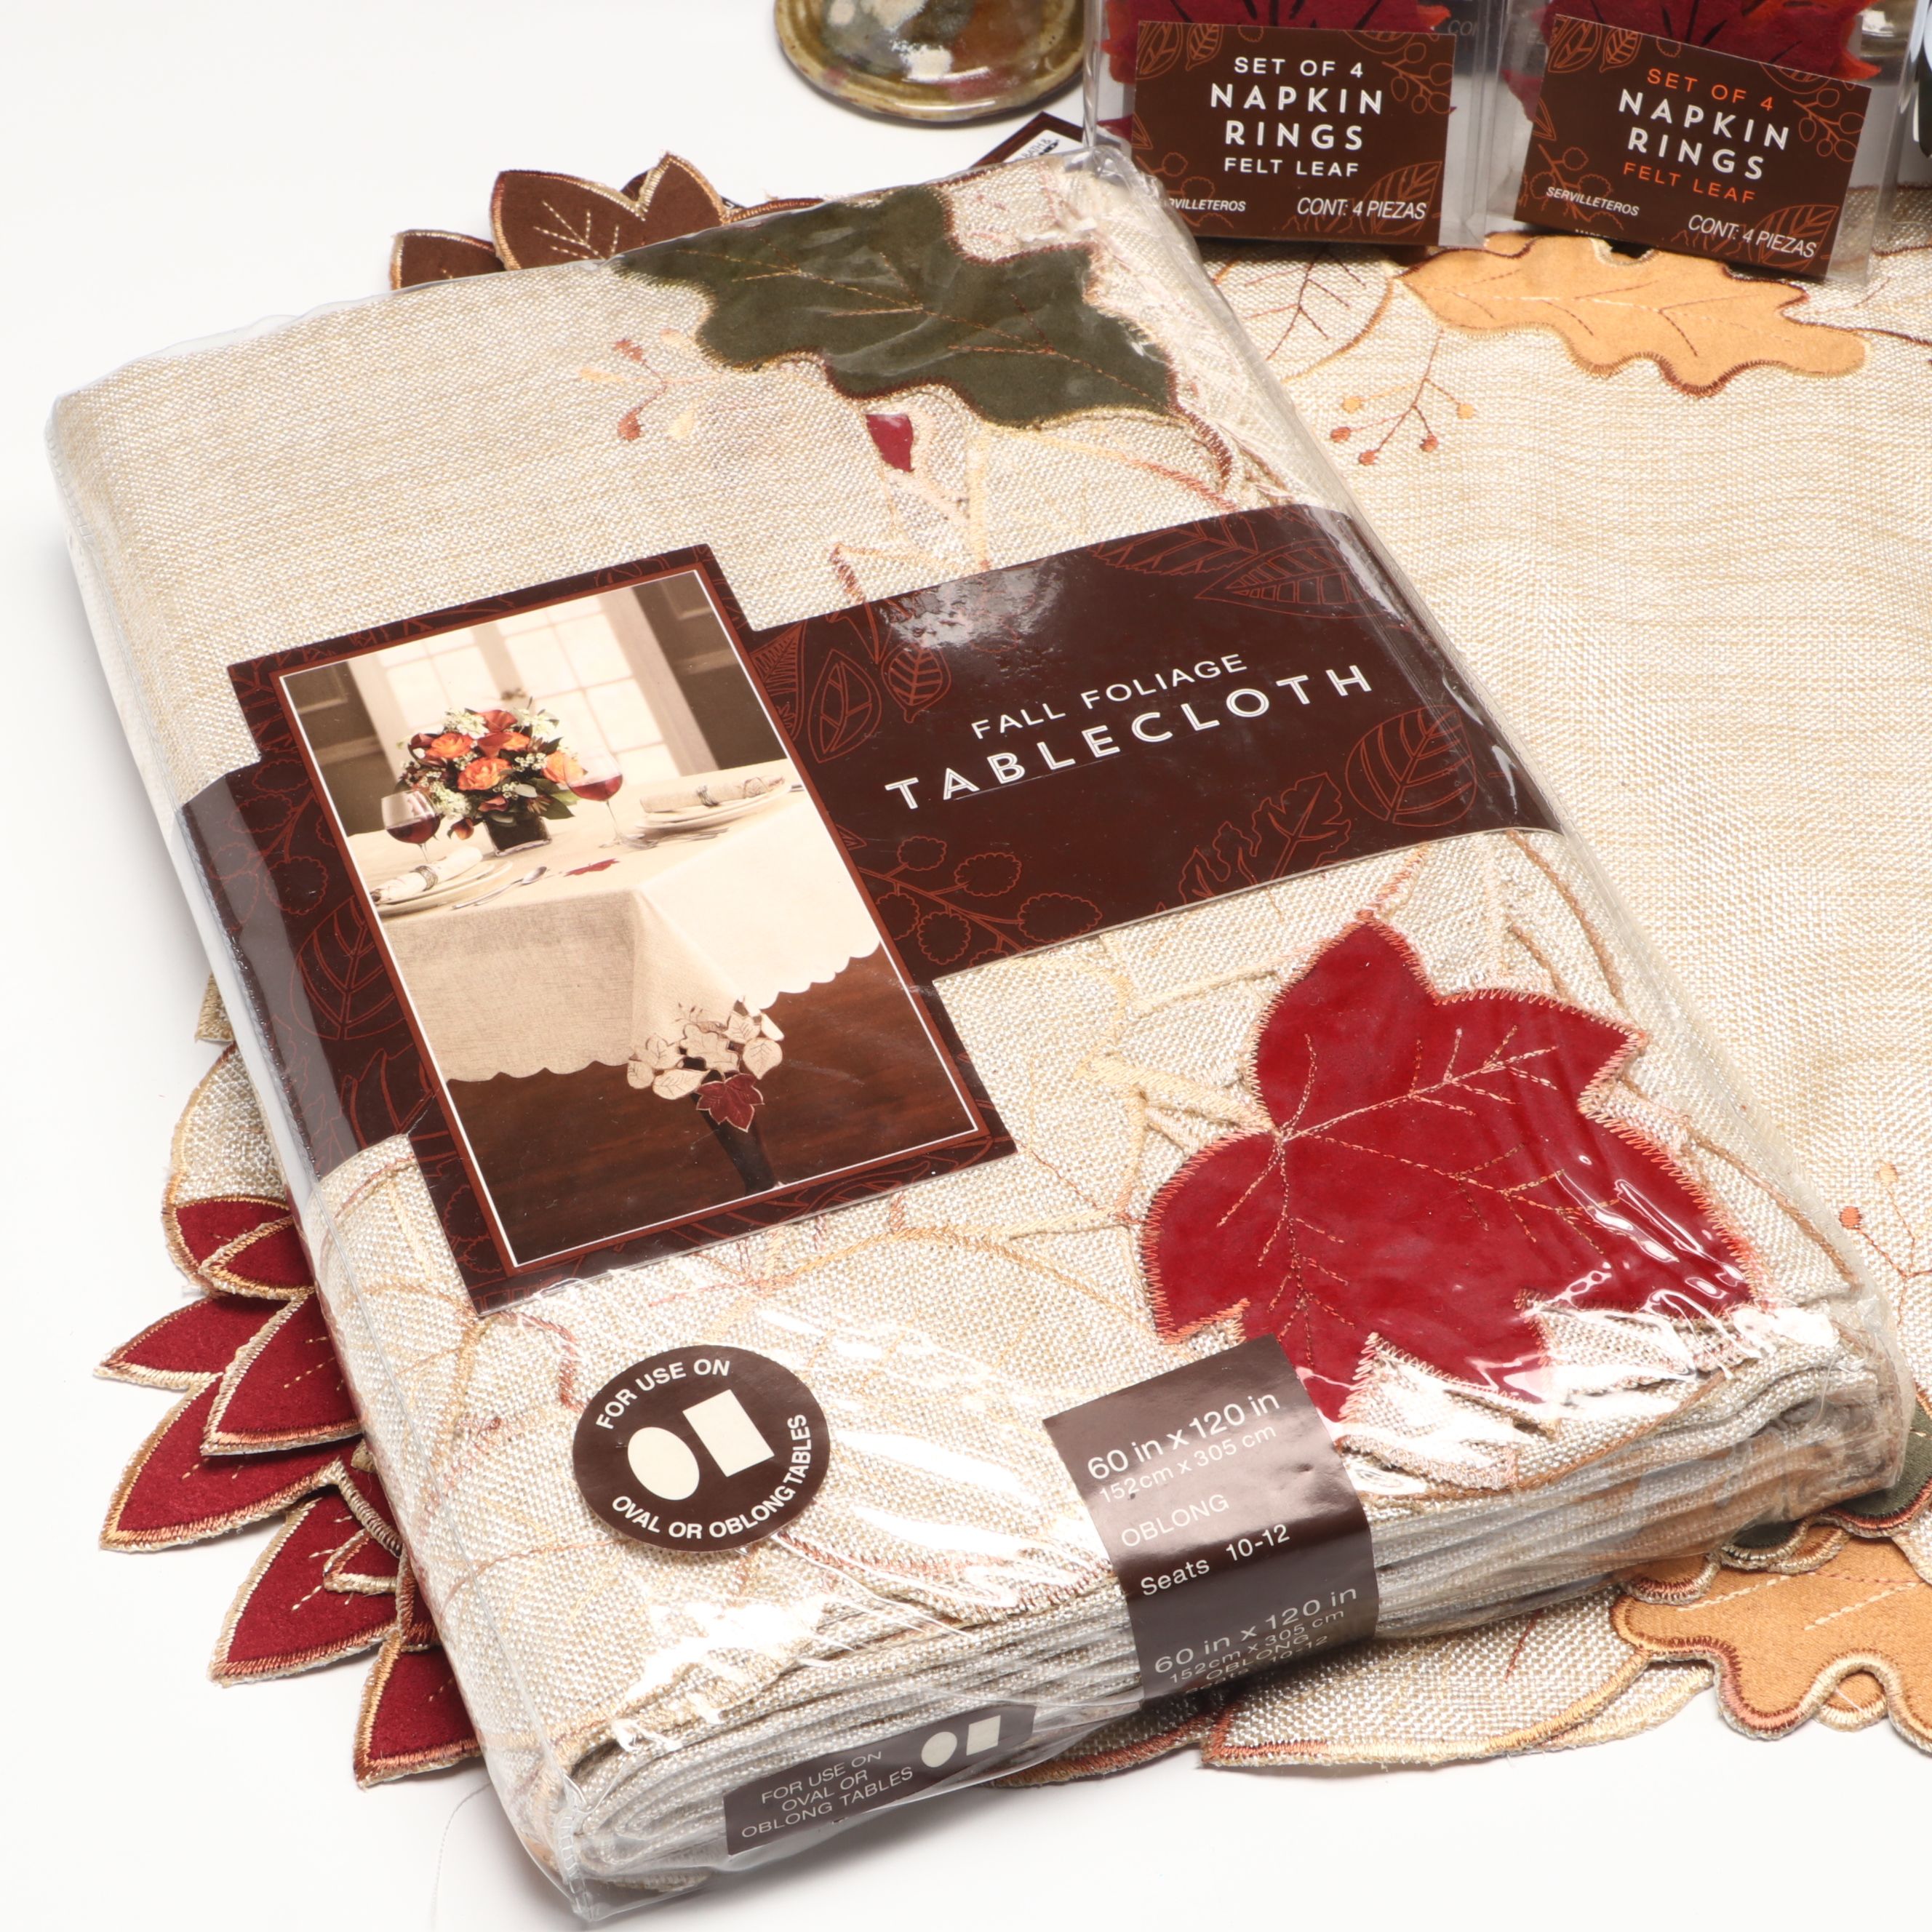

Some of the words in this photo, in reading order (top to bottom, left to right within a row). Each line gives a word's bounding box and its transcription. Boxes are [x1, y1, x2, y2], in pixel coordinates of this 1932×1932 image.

[1234, 57, 1285, 75] SET
[1300, 60, 1336, 76] OF
[1350, 63, 1363, 78] 4
[1647, 68, 1698, 92] SET
[1712, 84, 1747, 104] OF
[1760, 96, 1773, 111] 4
[1210, 83, 1383, 114] NAPKIN
[1618, 89, 1789, 151] NAPKIN
[1225, 121, 1363, 150] RINGS
[1628, 127, 1764, 180] RINGS
[1224, 157, 1283, 175] FELT
[1296, 160, 1359, 177] LEAF
[1624, 162, 1682, 187] FELT
[1693, 178, 1756, 204] LEAF
[1297, 197, 1349, 217] CONT:
[1352, 199, 1363, 217] 4
[1366, 199, 1426, 220] PIEZAS
[1546, 186, 1640, 216] SERVILLETEROS
[1688, 214, 1739, 241] CONT:
[1743, 228, 1754, 242] 4
[1755, 229, 1817, 259] PIEZAS
[970, 702, 1066, 741] FALL
[1080, 653, 1248, 710] FOLIAGE
[884, 665, 1372, 810] TABLECLOTH
[596, 1388, 638, 1429] FOR
[635, 1362, 687, 1392] USE
[693, 1359, 730, 1376] ON
[1087, 1448, 1129, 1480] 60
[1132, 1435, 1164, 1461] in
[1166, 1428, 1190, 1449] x
[1189, 1403, 1245, 1440] 120
[1248, 1393, 1280, 1417] in
[612, 1496, 660, 1533] OVAL
[668, 1522, 702, 1539] OR
[708, 1485, 796, 1538] OBLONG
[782, 1414, 812, 1485] TABLES
[1099, 1464, 1174, 1503] 152cm
[1178, 1460, 1192, 1474] x
[1196, 1438, 1237, 1467] 305
[1242, 1424, 1277, 1449] cm
[1121, 1493, 1229, 1546] OBLONG
[1140, 1557, 1210, 1597] Seats
[1226, 1523, 1290, 1562] 10-12
[1154, 1648, 1194, 1673] 60
[1204, 1635, 1230, 1655] in
[1241, 1626, 1258, 1641] x
[1266, 1599, 1321, 1629] 120
[1330, 1587, 1357, 1608] in
[1170, 1650, 1240, 1683] 152cm
[1247, 1642, 1259, 1653] x
[1265, 1623, 1305, 1646] 305
[1311, 1608, 1344, 1629] cm
[1271, 1636, 1328, 1662] 10-12
[1206, 1634, 1309, 1680] OBLONG
[741, 1803, 833, 1838] OBLONG
[839, 1766, 913, 1807] TABLES
[761, 1781, 802, 1804] FOR
[808, 1763, 845, 1788] USE
[851, 1752, 882, 1770] ON
[781, 1787, 834, 1812] OVAL
[840, 1770, 869, 1791] OR
